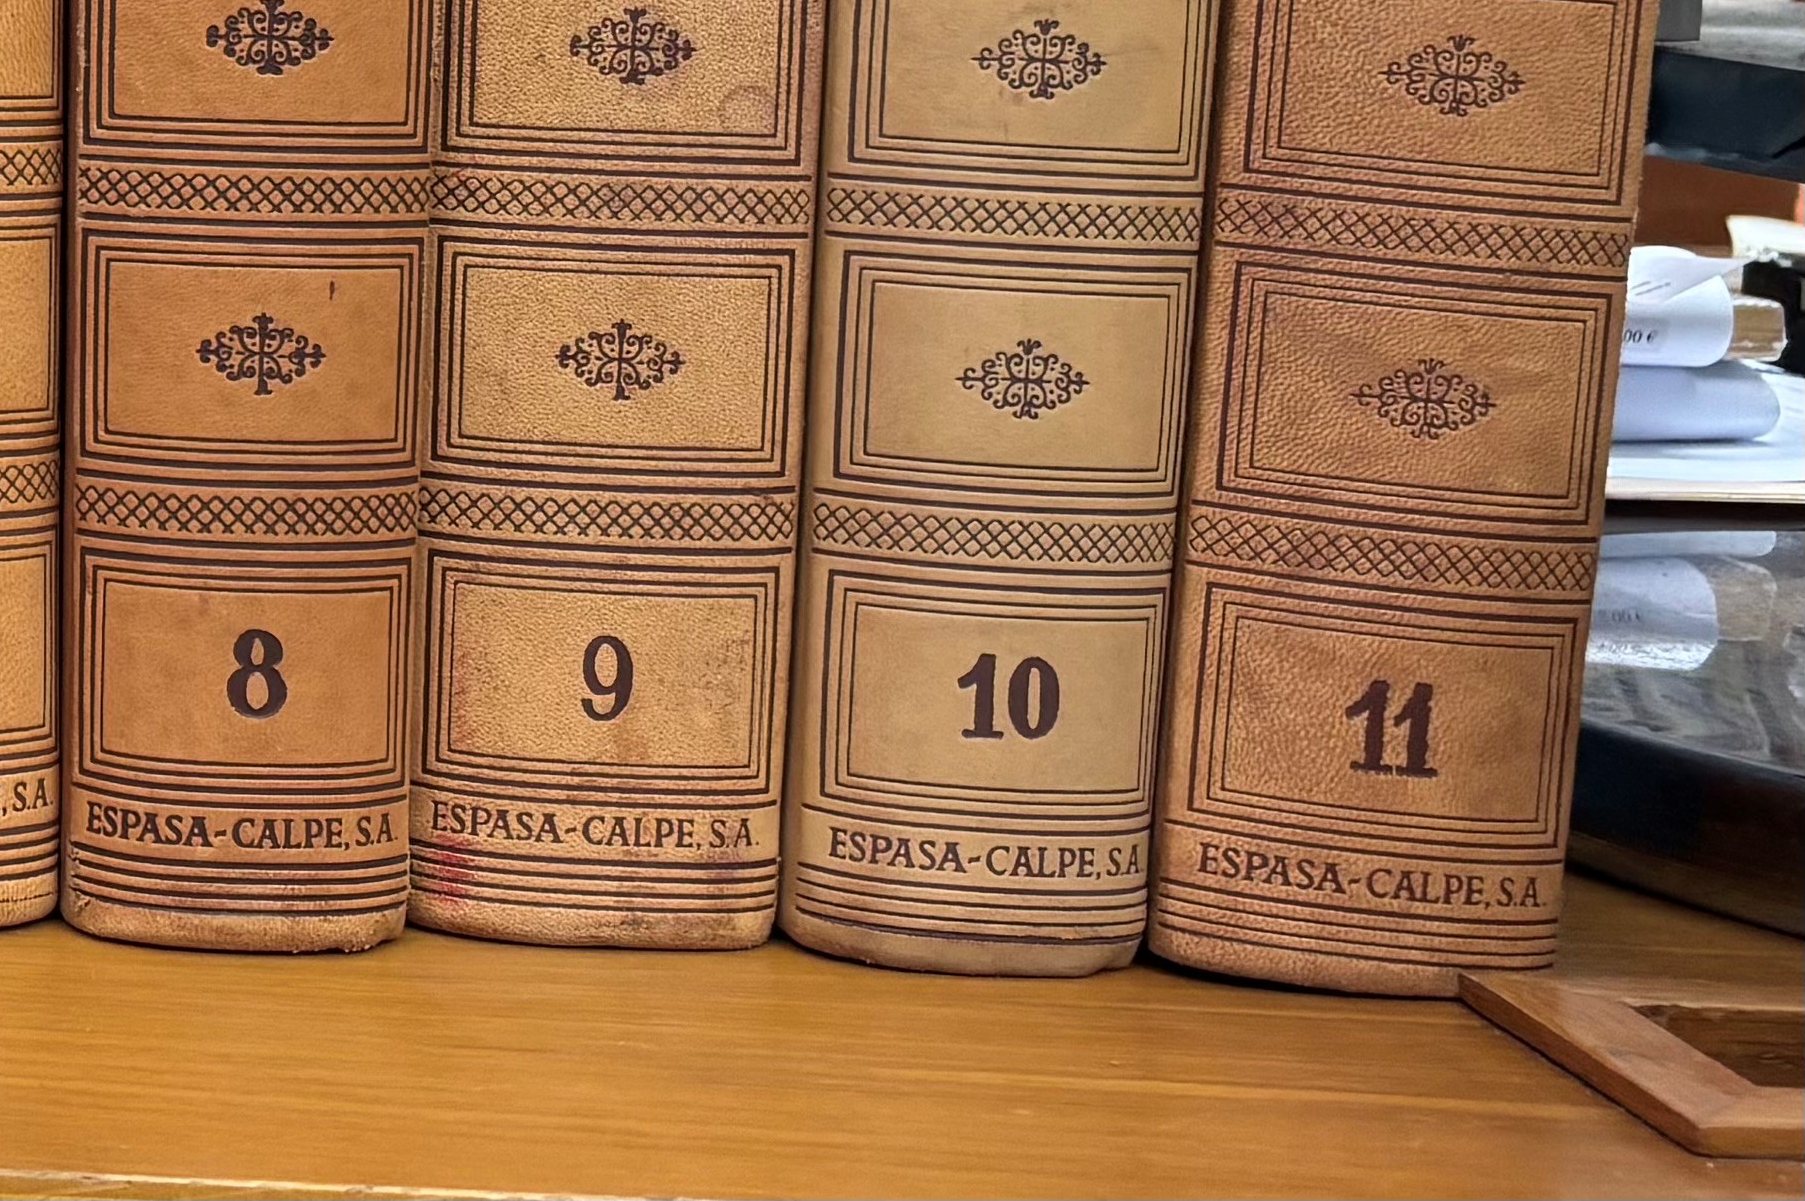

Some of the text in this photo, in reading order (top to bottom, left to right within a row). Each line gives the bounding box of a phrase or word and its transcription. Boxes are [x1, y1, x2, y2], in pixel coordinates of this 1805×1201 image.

[226, 628, 288, 719] 8
[580, 635, 634, 722] 9
[957, 653, 1060, 740] 10
[1345, 679, 1438, 778] 11
